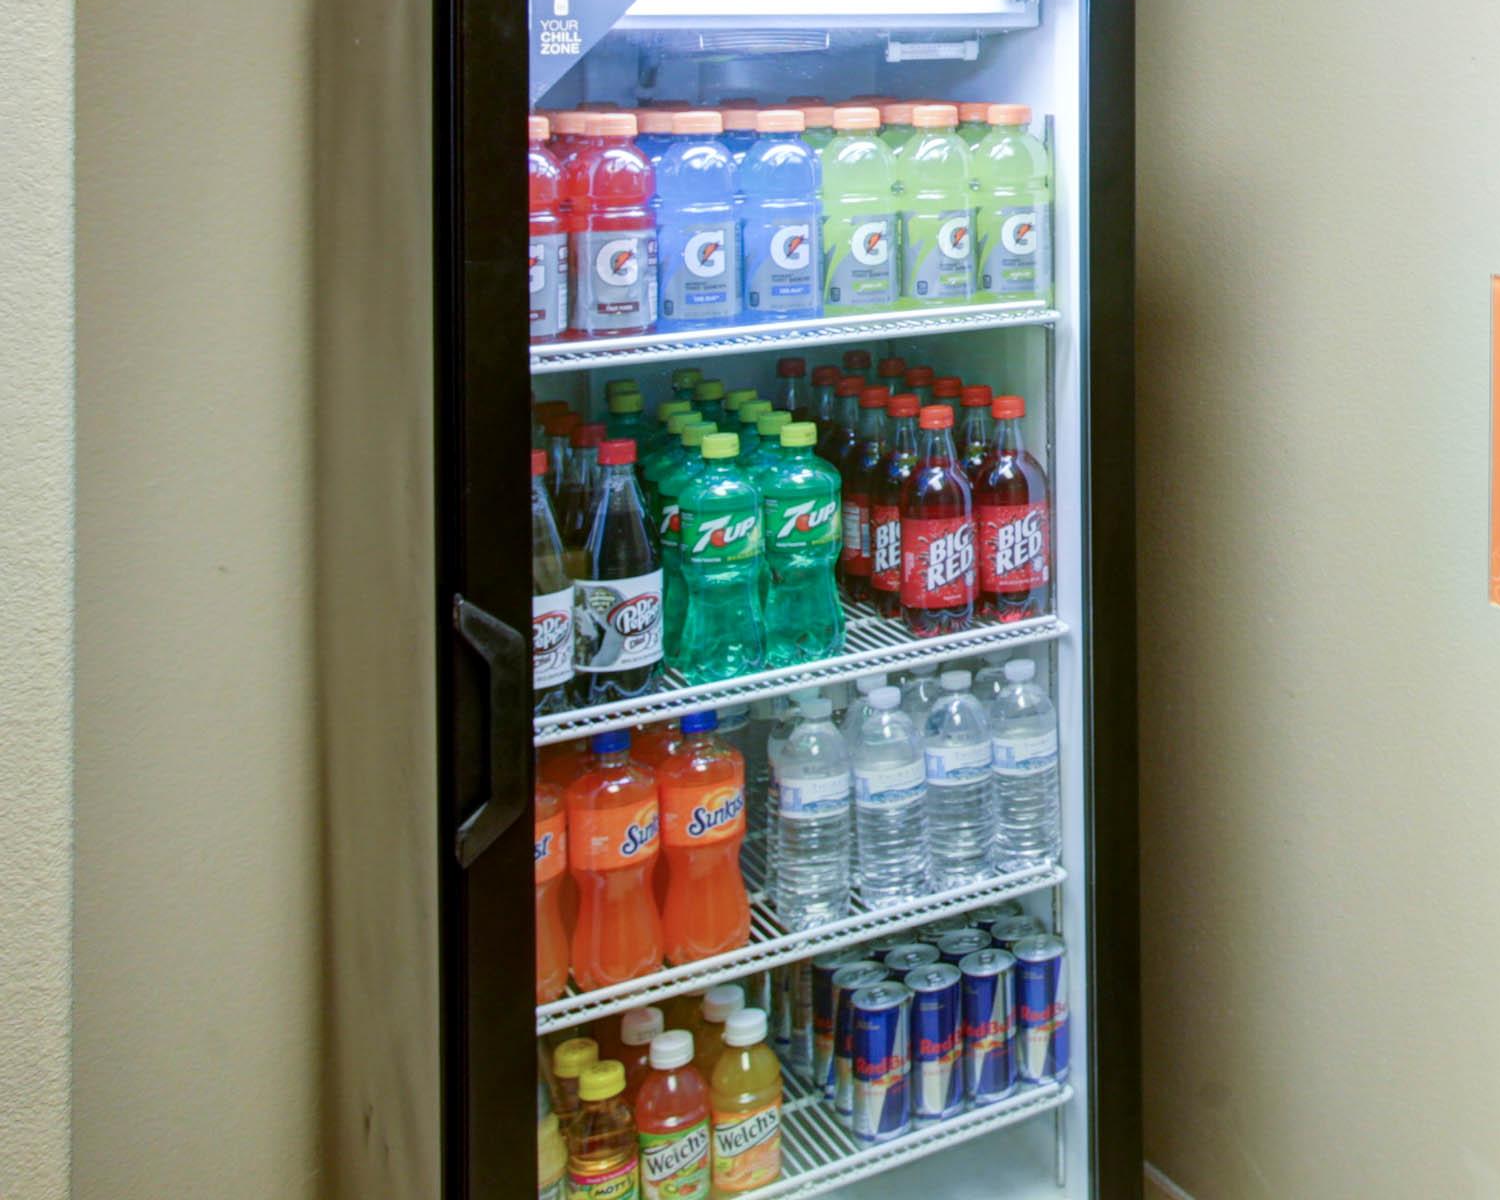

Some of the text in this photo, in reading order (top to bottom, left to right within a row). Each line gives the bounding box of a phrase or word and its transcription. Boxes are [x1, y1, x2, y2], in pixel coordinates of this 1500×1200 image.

[541, 19, 578, 32] YOUR
[541, 31, 582, 44] CHILL
[540, 42, 580, 55] ZONE
[684, 231, 725, 278] G
[769, 225, 810, 271] G
[851, 221, 889, 266] G
[938, 216, 969, 259] G
[1001, 213, 1036, 255] G
[597, 238, 639, 286] G
[692, 514, 756, 553] 7UP
[777, 500, 837, 538] 7UP
[998, 510, 1039, 551] BIG
[875, 542, 901, 573] RE
[929, 523, 971, 566] BIG
[996, 531, 1043, 575] RED
[927, 544, 974, 591] RED
[645, 1127, 707, 1176] Welch's
[715, 1108, 777, 1152] Welch's
